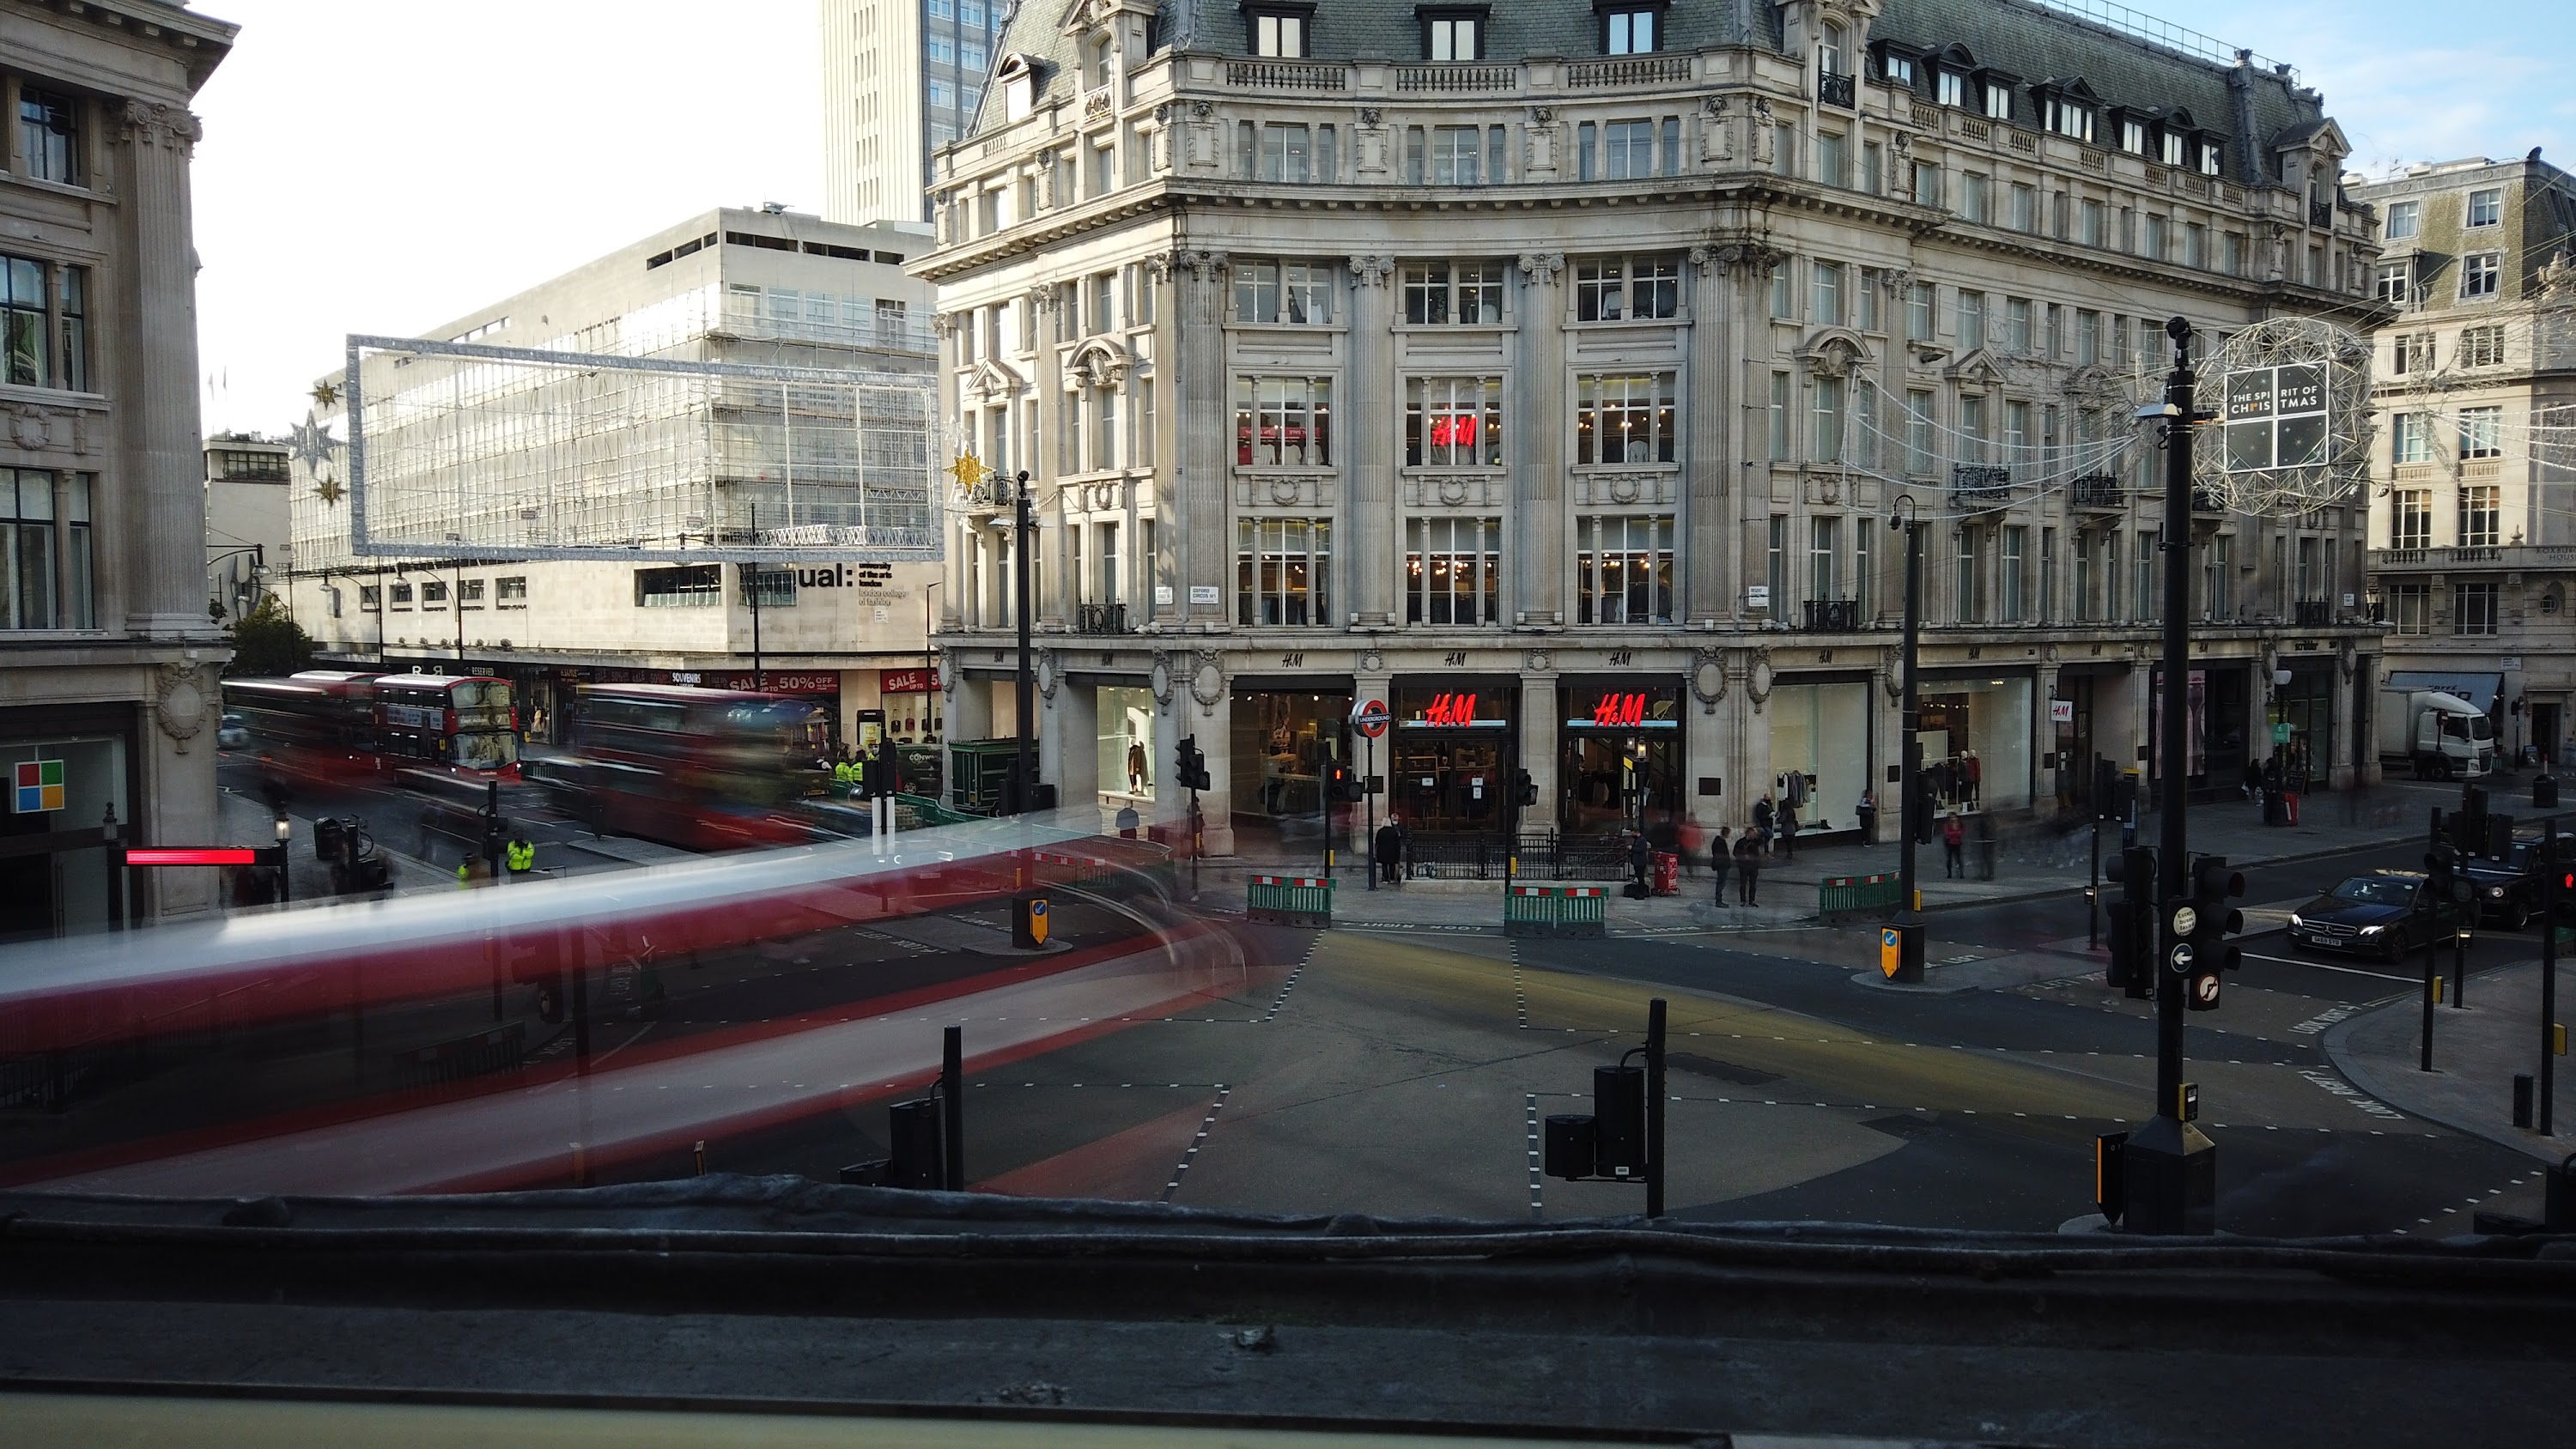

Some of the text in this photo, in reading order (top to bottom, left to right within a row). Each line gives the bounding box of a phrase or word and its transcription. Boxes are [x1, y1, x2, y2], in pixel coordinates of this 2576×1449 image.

[2233, 393, 2251, 403] THE
[2302, 385, 2318, 395] OF
[859, 588, 882, 597] london
[1281, 653, 1303, 667] H&M
[1444, 652, 1467, 666] H&M
[1609, 652, 1631, 666] H&M
[471, 666, 494, 676] RESERVED
[671, 672, 702, 683] SOUVENIRS
[779, 676, 816, 689] 50%
[888, 671, 917, 691] SALE
[1425, 693, 1477, 727] H&M
[1594, 693, 1646, 727] H&M
[2053, 705, 2069, 718] H&M
[2177, 910, 2194, 919] Except
[2303, 1075, 2406, 1119] LOOK RIGHT
